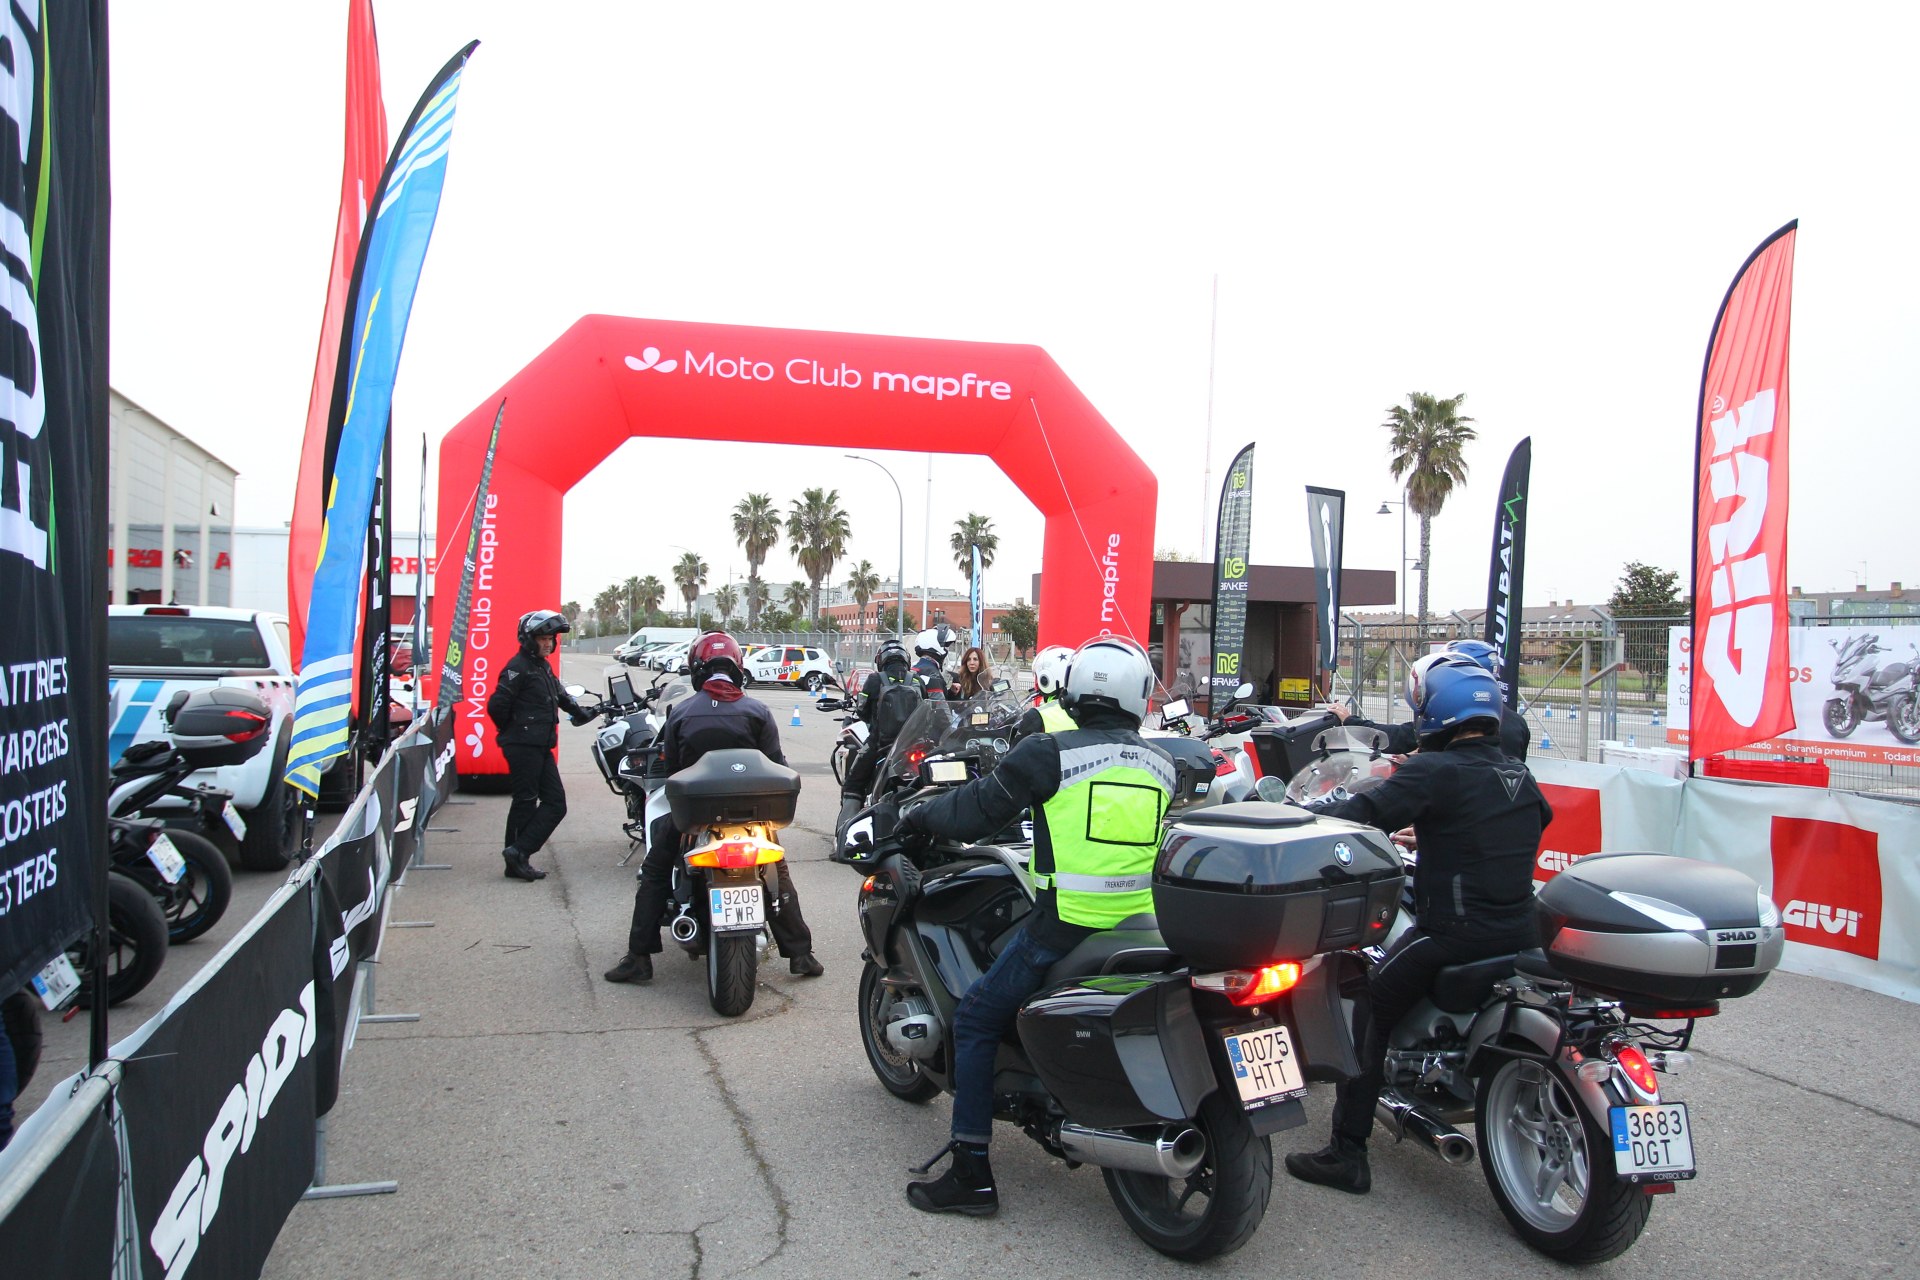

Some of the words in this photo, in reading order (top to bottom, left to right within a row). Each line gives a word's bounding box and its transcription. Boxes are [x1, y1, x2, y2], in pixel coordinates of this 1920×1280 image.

[684, 350, 774, 381] Moto
[785, 358, 862, 389] Club
[872, 370, 1011, 401] mapfre
[1101, 533, 1121, 622] mapfre
[471, 597, 491, 650] Club
[758, 670, 770, 678] LA
[773, 664, 800, 675] TORRE
[467, 657, 488, 718] Moto
[1823, 748, 1867, 759] premium
[1882, 751, 1911, 762] Todas
[1537, 849, 1584, 873] GIV
[723, 888, 759, 905] 9209
[724, 906, 755, 923] FWR
[1781, 899, 1858, 938] GIVI
[1716, 931, 1757, 942] SHAD
[1241, 1031, 1289, 1064] 0075
[1251, 1059, 1287, 1091] HTT
[1629, 1110, 1683, 1138] 3683
[1632, 1138, 1671, 1167] DGT
